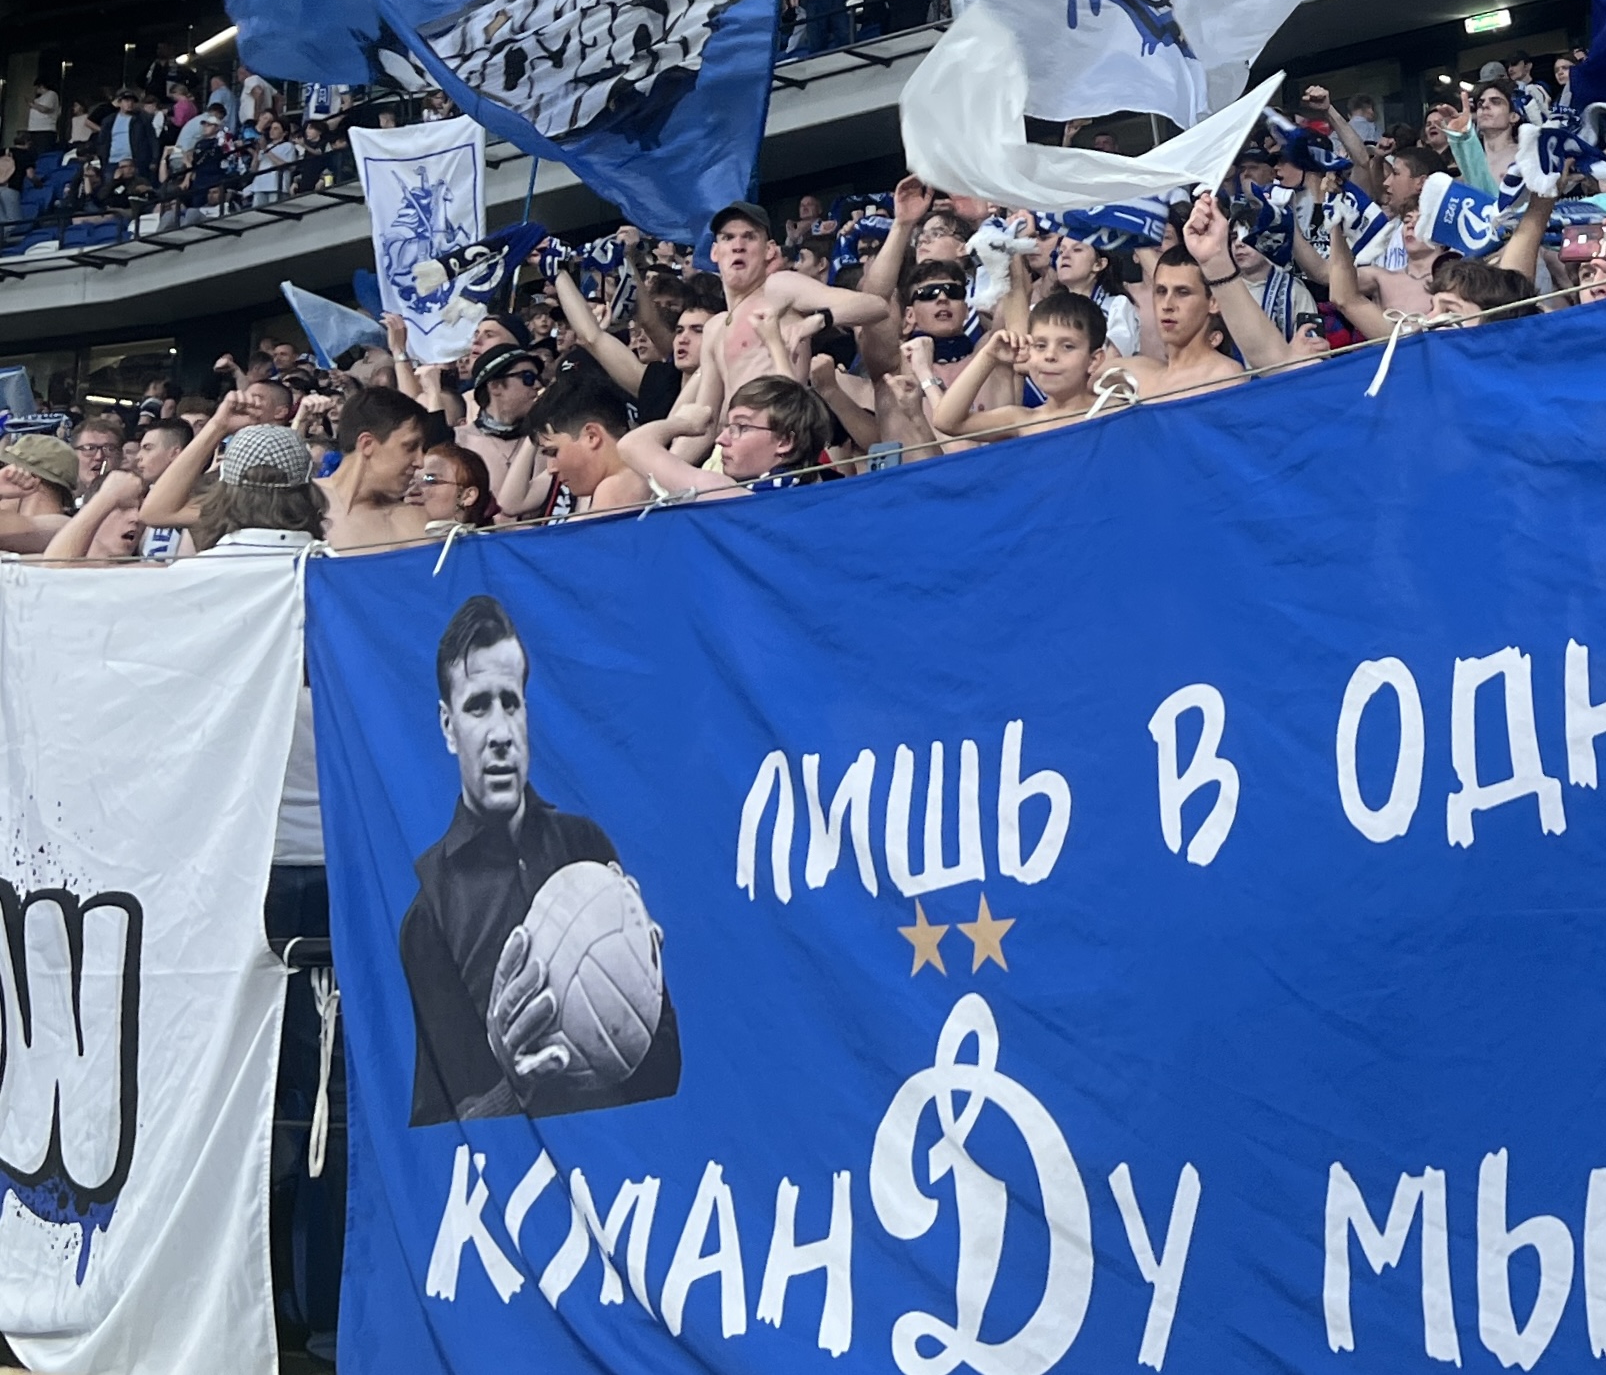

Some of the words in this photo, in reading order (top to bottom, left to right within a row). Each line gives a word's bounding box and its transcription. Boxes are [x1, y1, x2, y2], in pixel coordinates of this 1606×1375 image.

[736, 719, 1072, 905] ЛИШЬ
[1148, 683, 1240, 866] В
[425, 991, 1202, 1375] КОМАНДУ
